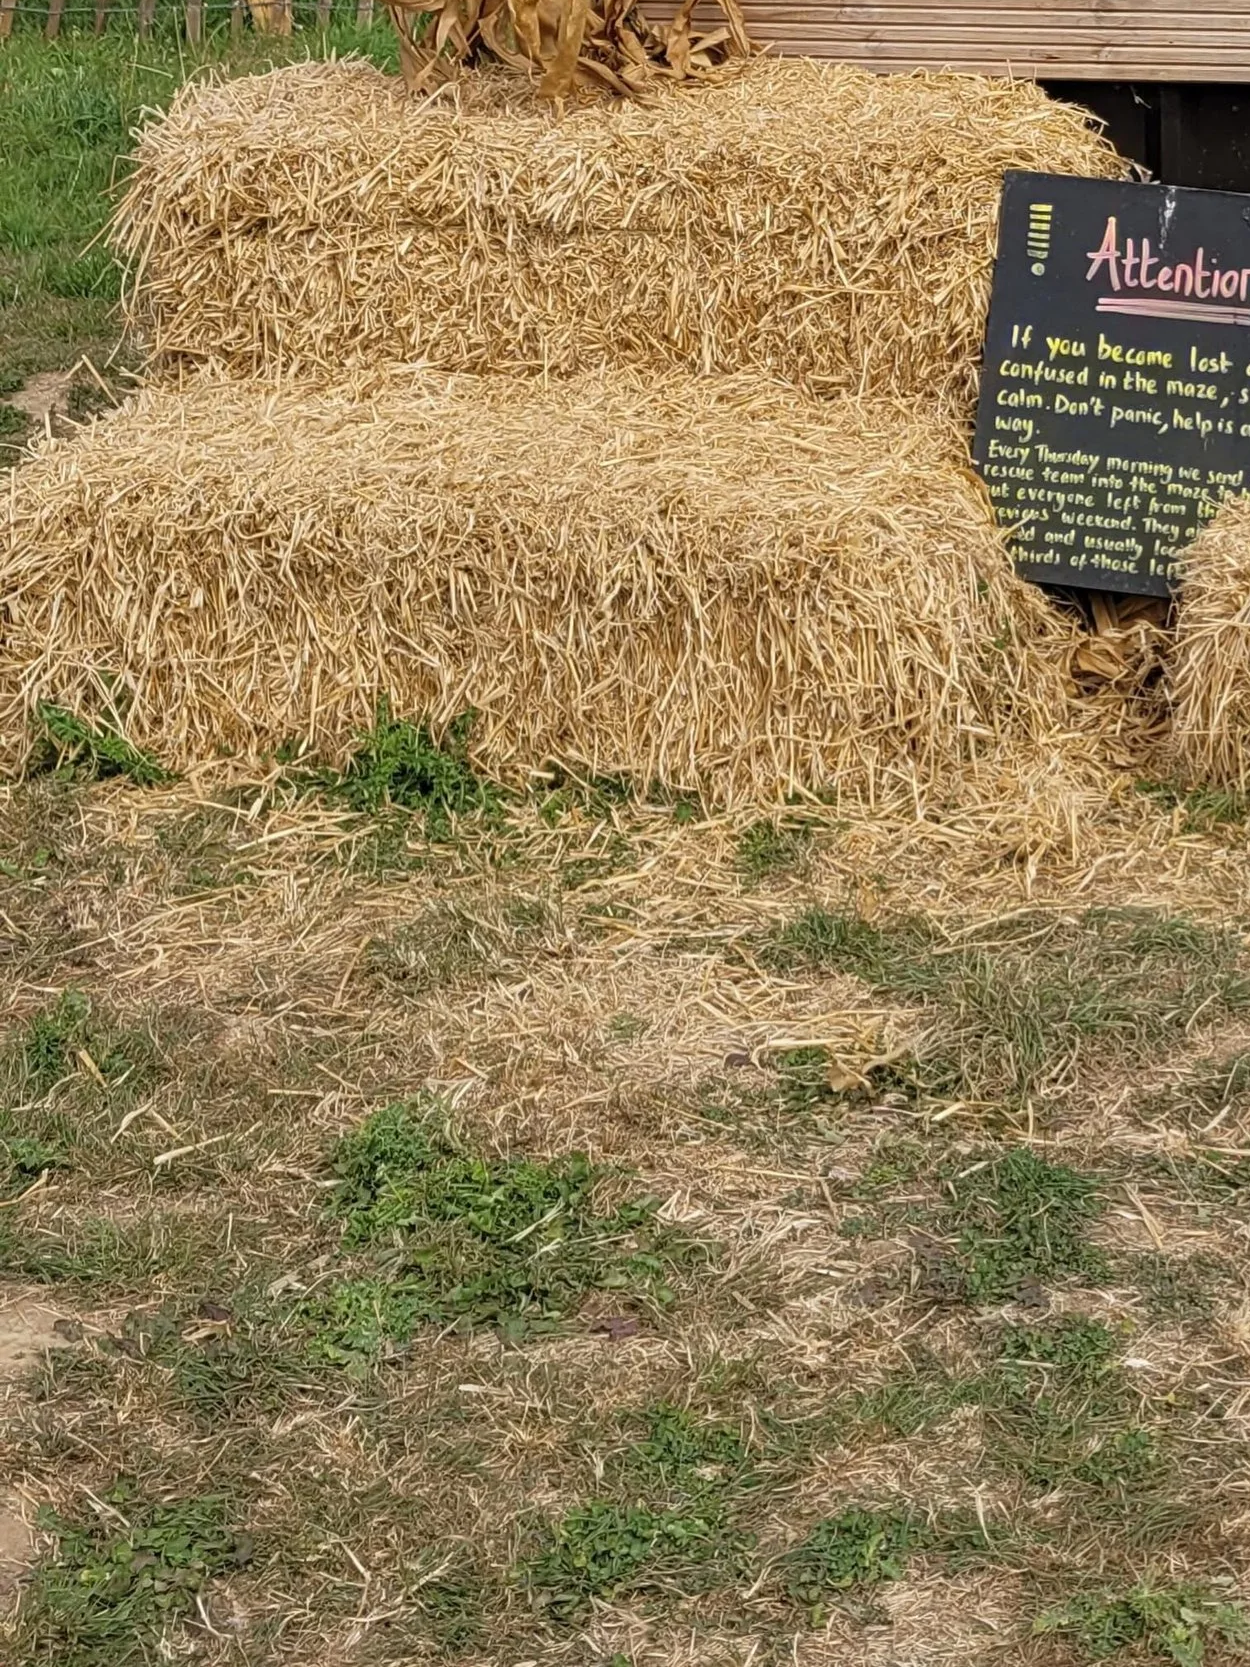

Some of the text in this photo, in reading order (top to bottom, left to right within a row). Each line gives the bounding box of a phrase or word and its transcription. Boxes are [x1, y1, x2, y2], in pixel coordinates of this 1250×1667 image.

[1012, 324, 1033, 349] If
[1046, 336, 1086, 361] you
[1098, 333, 1172, 368] become
[1190, 346, 1233, 373] lost
[1000, 359, 1088, 386] confused
[1099, 371, 1116, 389] in
[1123, 371, 1157, 394] the
[995, 415, 1040, 443] way.
[996, 388, 1050, 410] calm.
[1055, 394, 1105, 416] Don't
[1109, 406, 1168, 434] panic,
[1173, 408, 1212, 438] help
[1217, 418, 1234, 434] is
[988, 439, 1030, 465] Every
[1035, 444, 1099, 474] Thursday
[1107, 457, 1173, 484] morning
[1178, 467, 1201, 481] we
[1206, 470, 1244, 487] send
[984, 464, 1034, 481] rescue
[1042, 467, 1084, 484] team
[1092, 473, 1123, 489] into
[1129, 476, 1157, 494] the
[1167, 483, 1209, 499] maze
[987, 483, 1215, 518] ut everyone left from th
[1044, 529, 1076, 545] and
[1084, 536, 1143, 560] usually
[1061, 512, 1136, 531] weekend.
[1142, 517, 1179, 542] They
[1070, 553, 1088, 571] of
[1091, 553, 1139, 574] those
